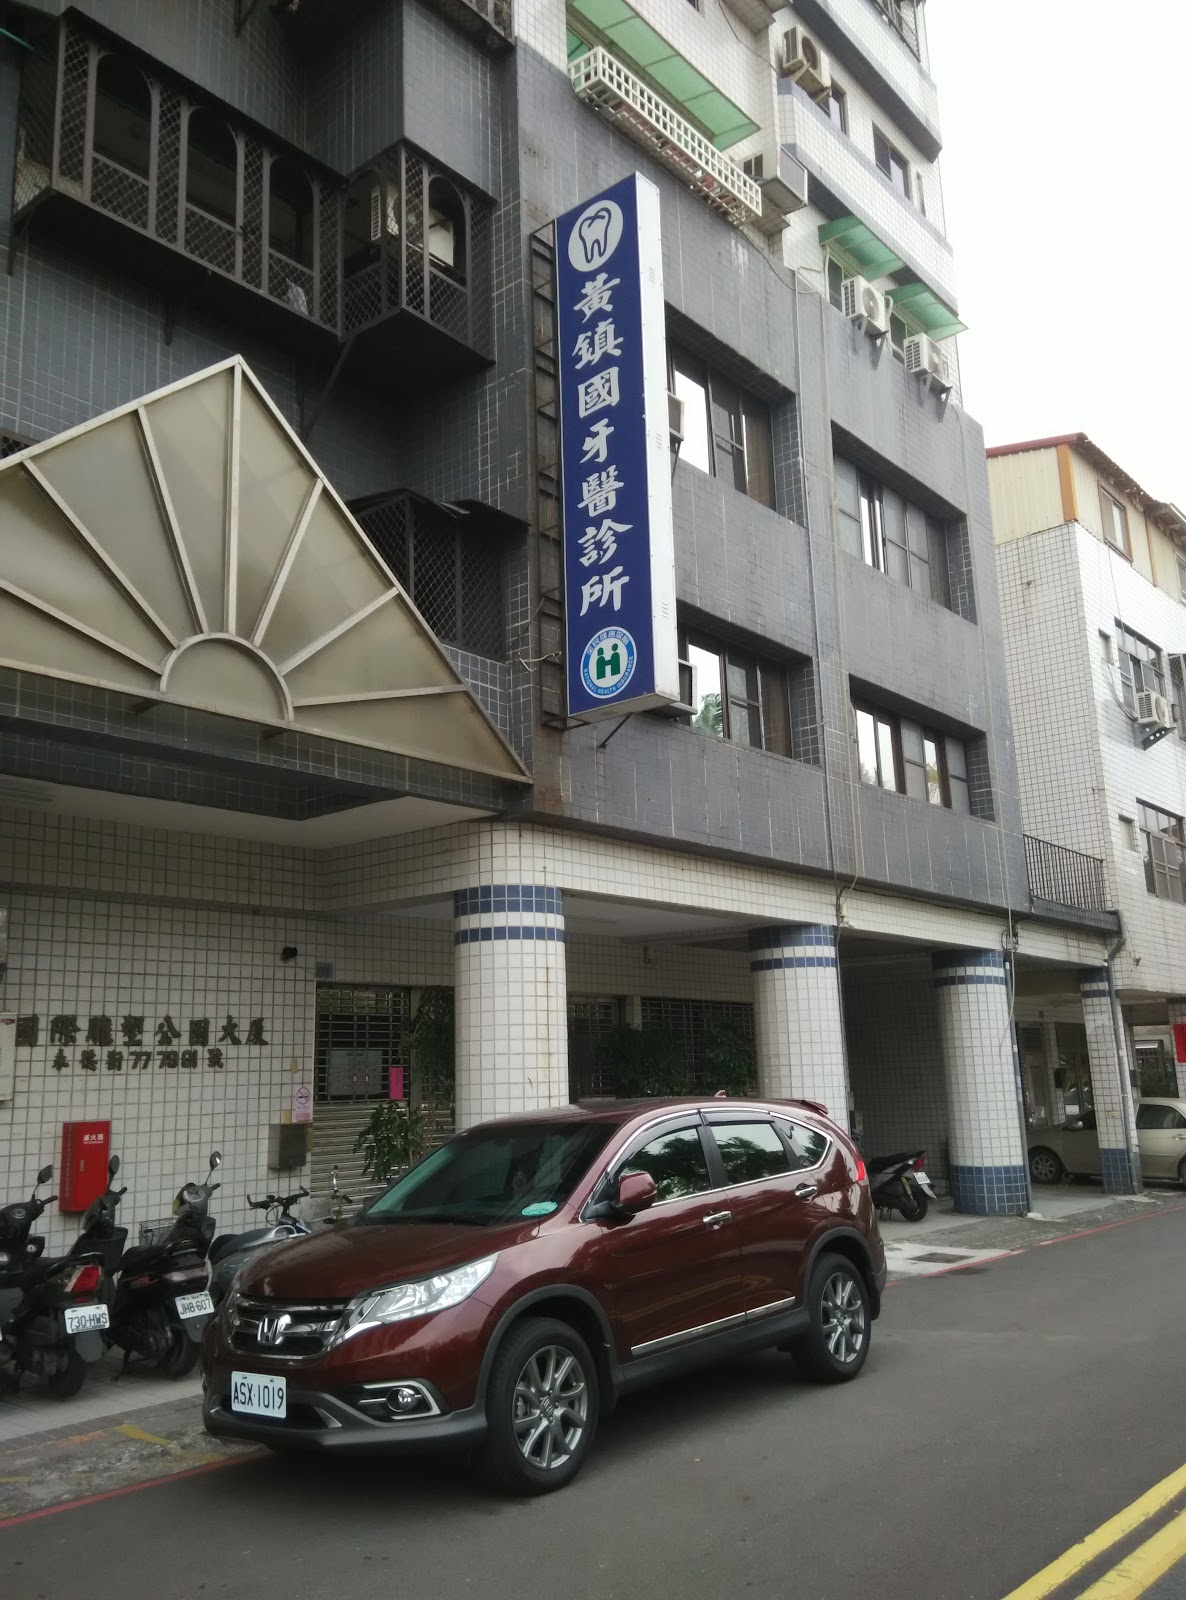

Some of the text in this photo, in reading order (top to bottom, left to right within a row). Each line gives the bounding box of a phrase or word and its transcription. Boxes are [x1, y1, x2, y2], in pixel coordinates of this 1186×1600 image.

[572, 272, 633, 616] 黃鎮國牙醫診所
[583, 655, 634, 694] NATIONAL HEALTH INSURANCE
